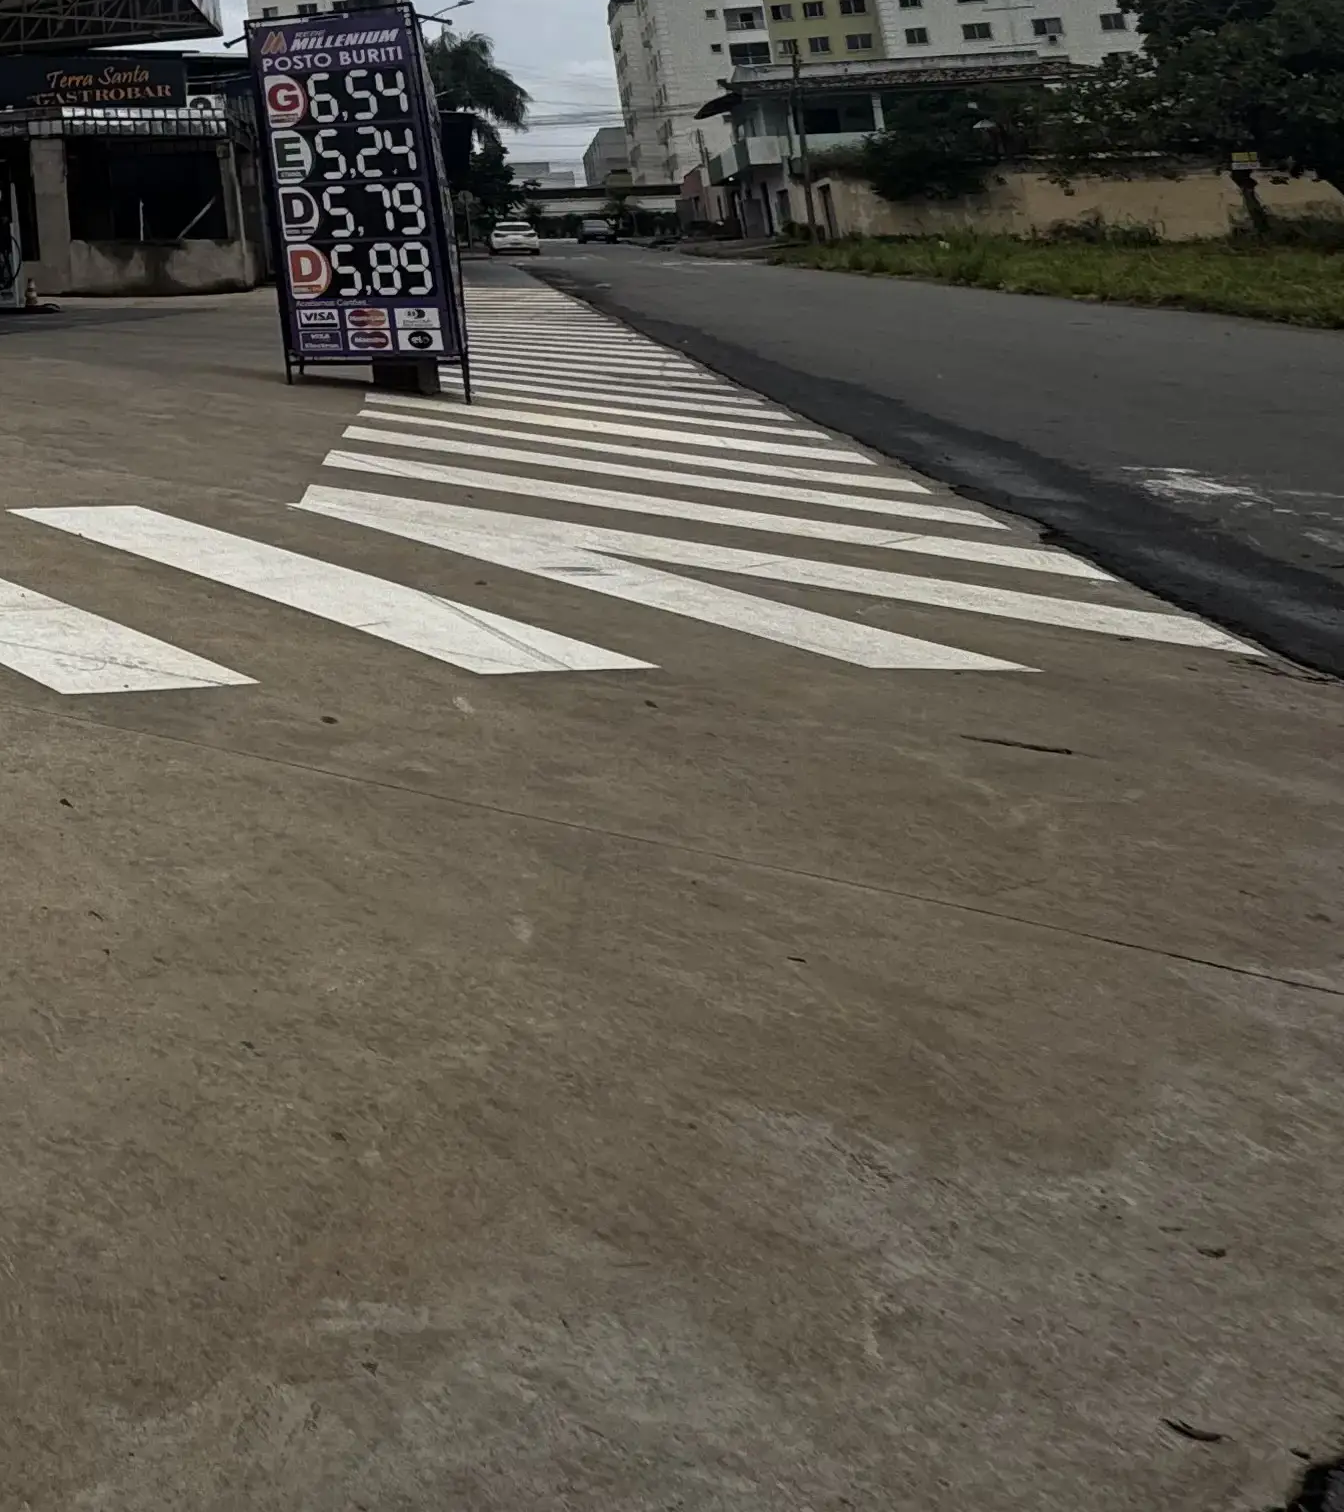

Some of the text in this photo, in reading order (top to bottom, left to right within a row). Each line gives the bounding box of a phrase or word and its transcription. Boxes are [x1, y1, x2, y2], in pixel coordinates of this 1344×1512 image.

[290, 28, 400, 52] MILLENIUM
[262, 45, 404, 72] POSTO BURITI
[46, 64, 150, 89] Terra Santa
[29, 85, 172, 105] GASTROBAR
[268, 69, 408, 124] G 6,54
[274, 126, 417, 180] E 5,24
[281, 182, 427, 239] D 5,79
[290, 242, 434, 297] D 5,89
[303, 312, 336, 321] VISA
